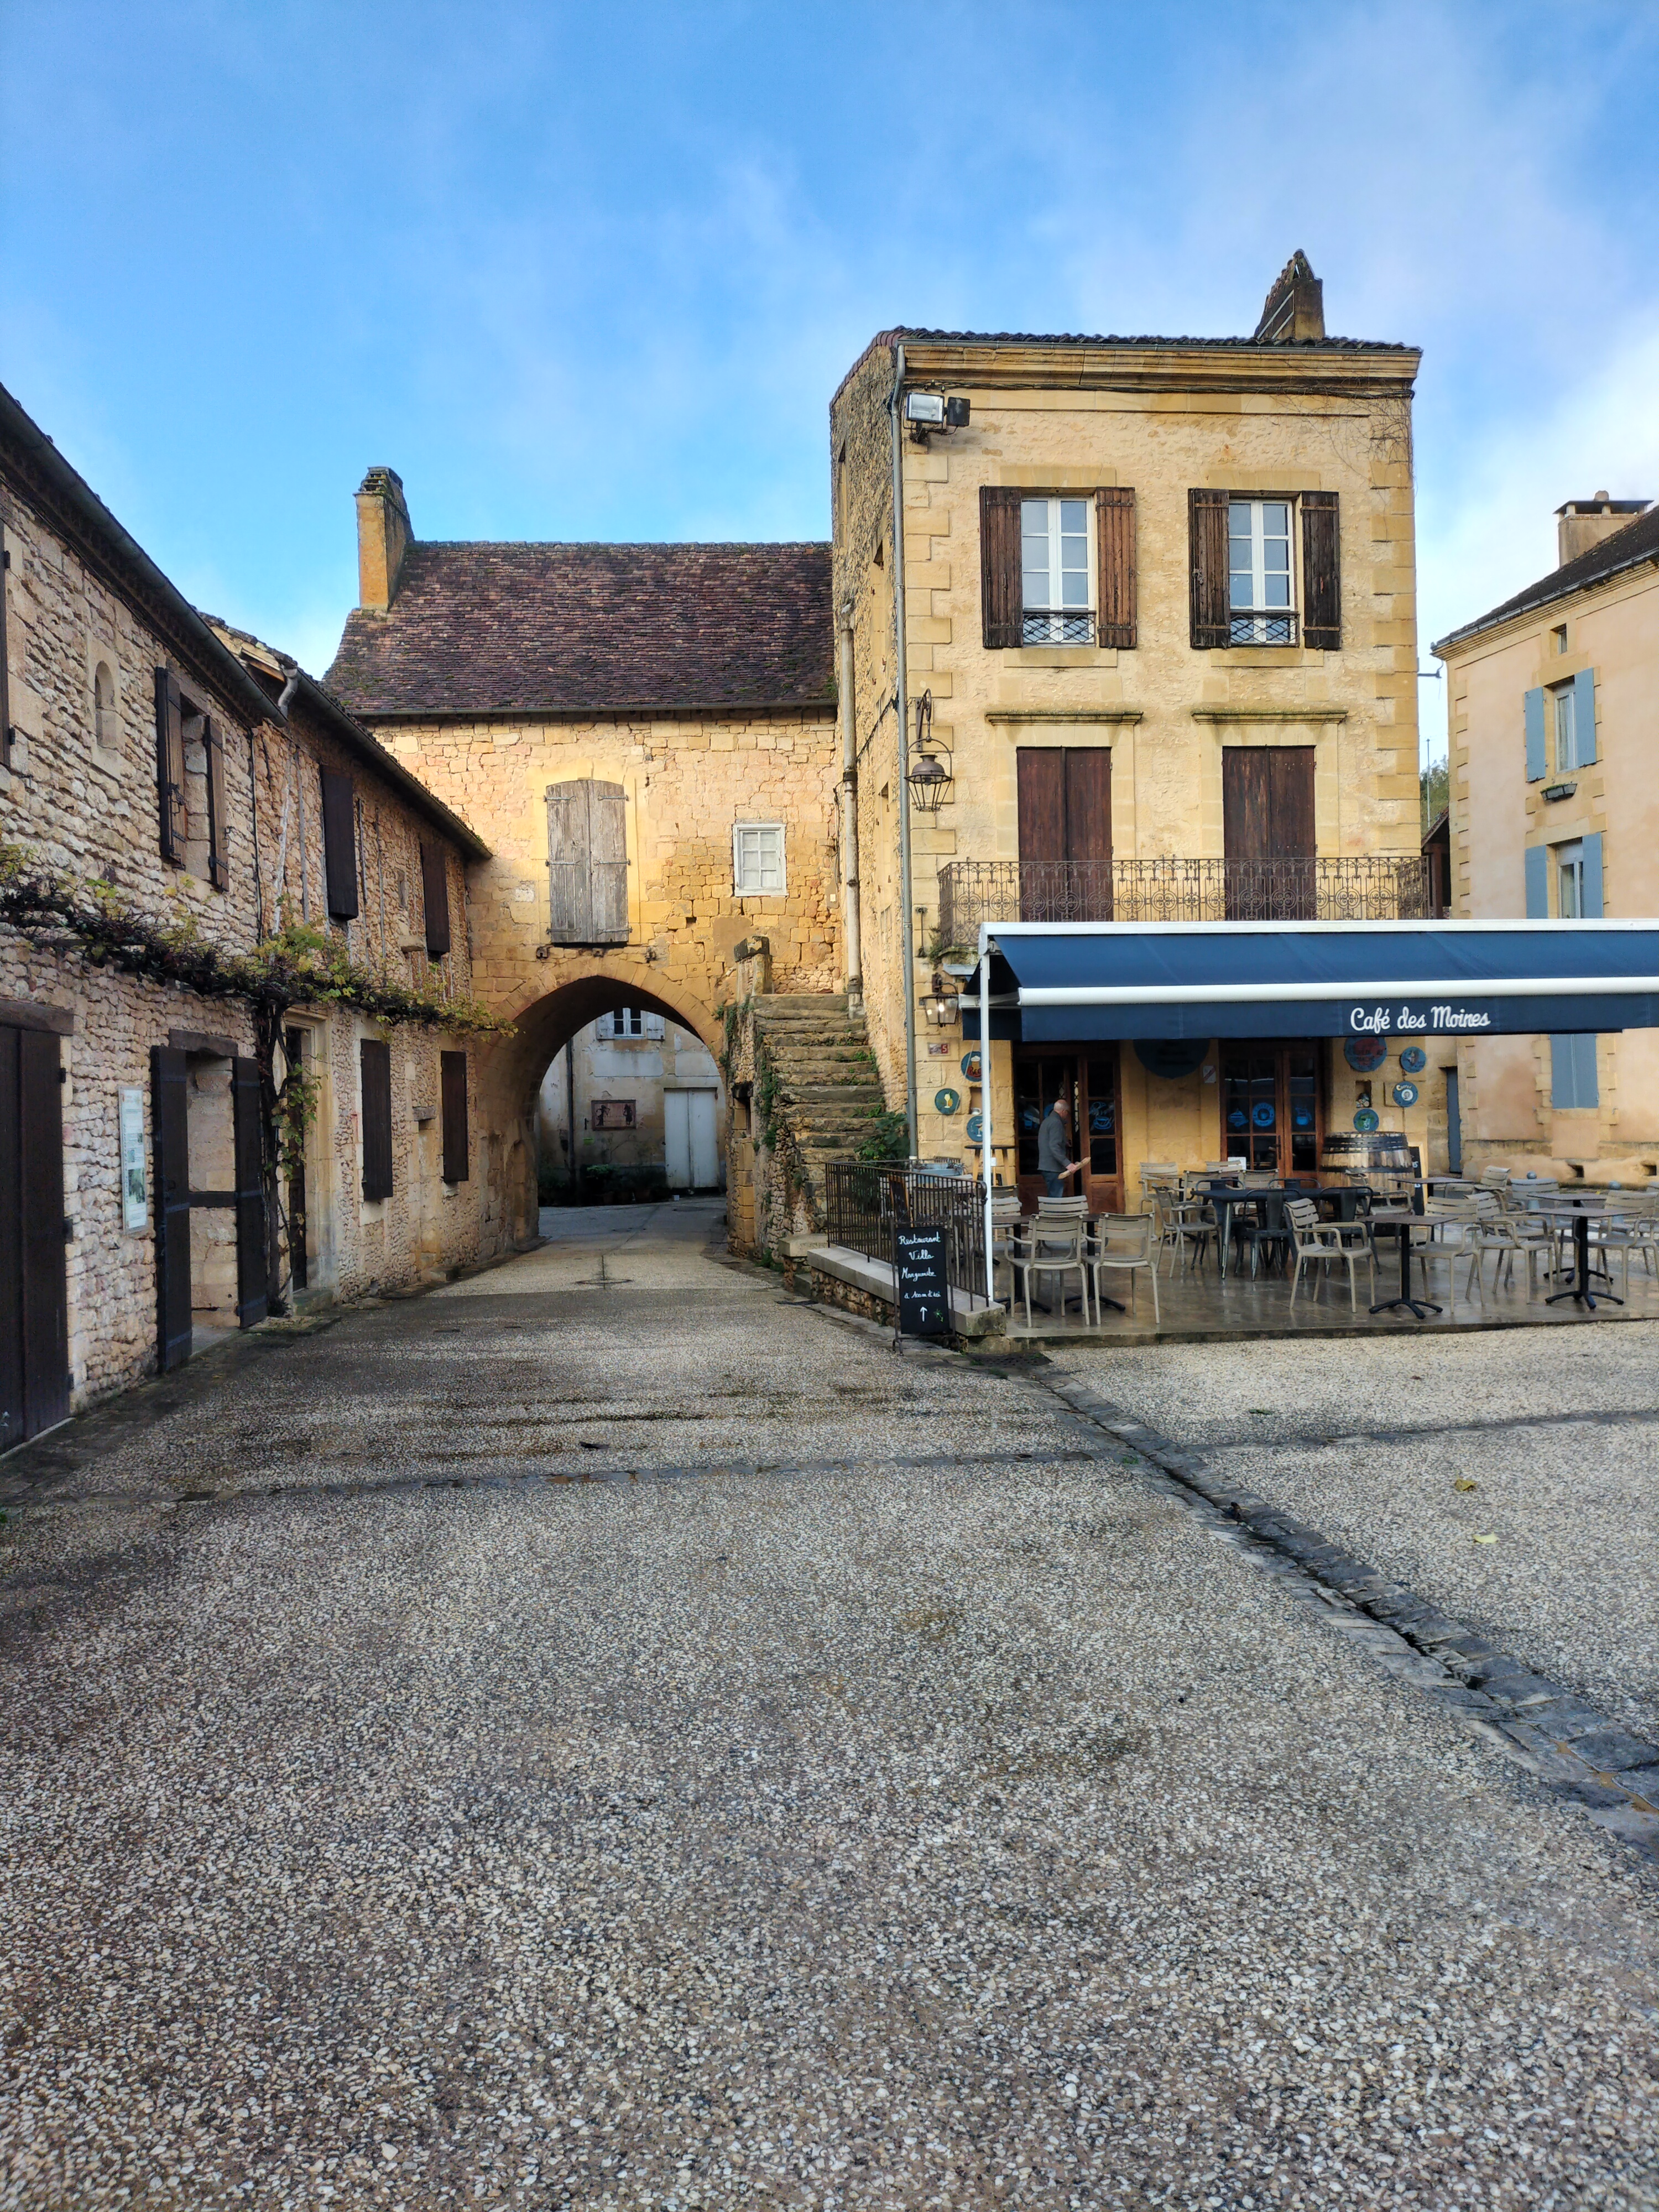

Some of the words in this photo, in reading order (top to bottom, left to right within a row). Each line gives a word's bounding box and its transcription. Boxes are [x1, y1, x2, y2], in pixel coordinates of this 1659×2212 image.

[1350, 1007, 1390, 1034] Café
[1397, 1006, 1427, 1029] des
[1431, 1005, 1491, 1029] Moines
[942, 1044, 947, 1053] 5
[898, 1231, 941, 1245] Restaurant
[909, 1249, 935, 1260] Villa
